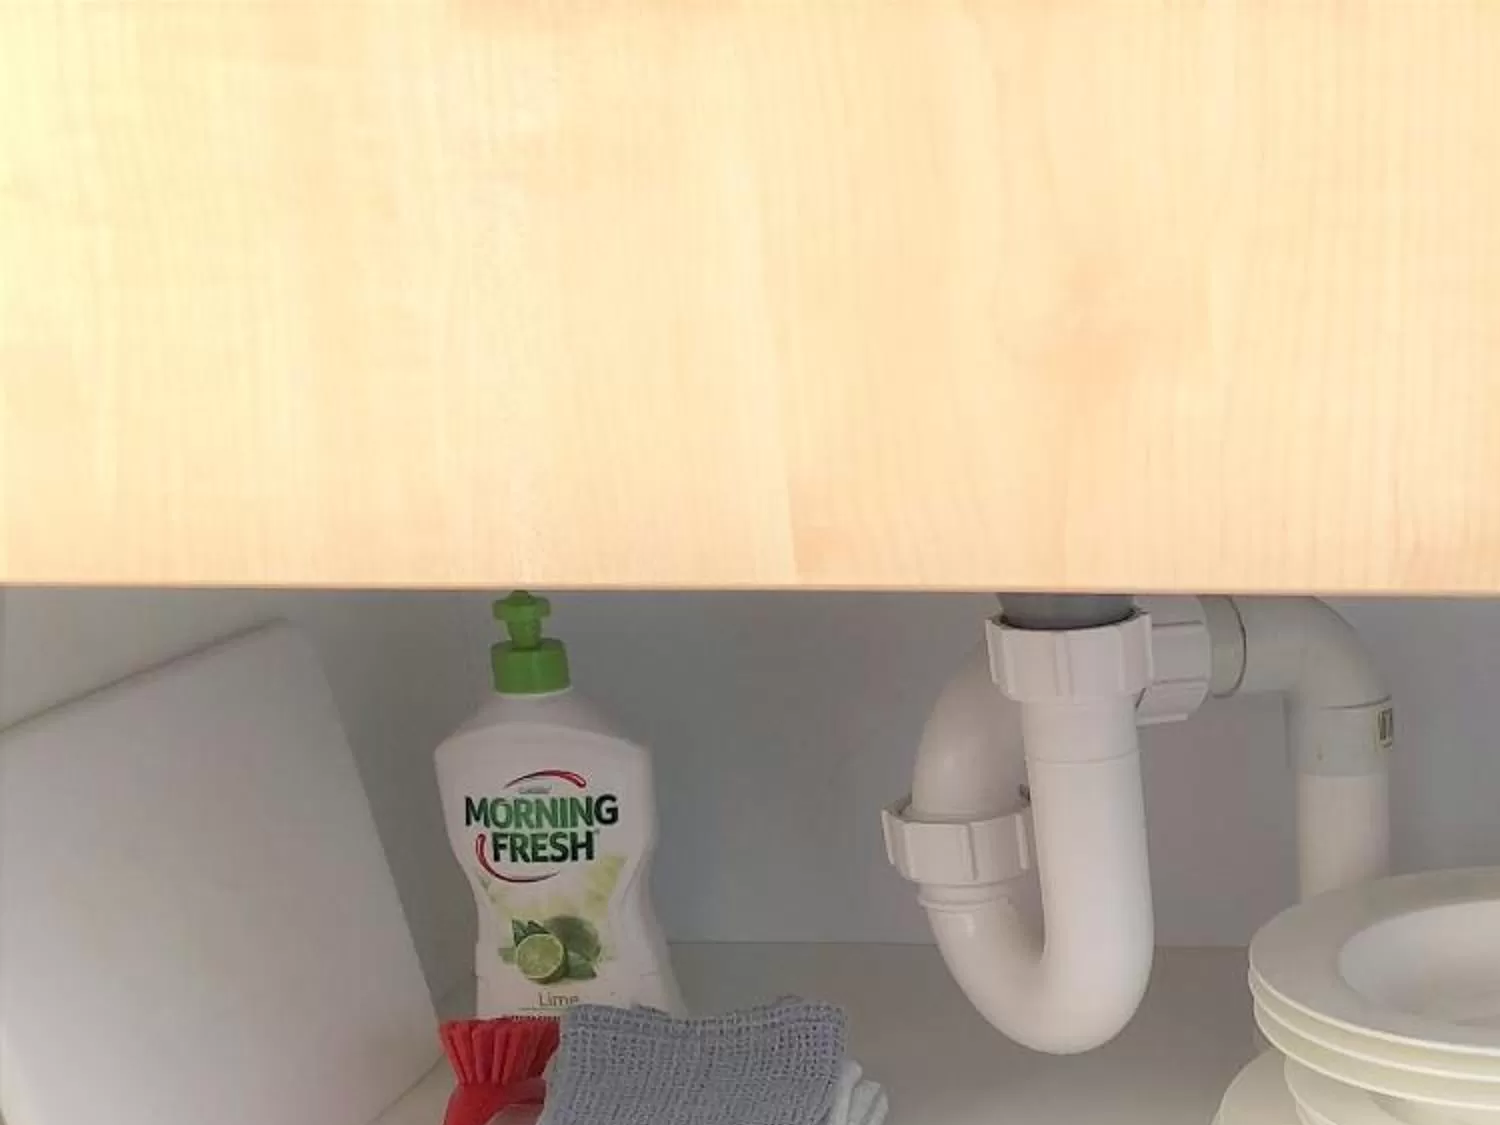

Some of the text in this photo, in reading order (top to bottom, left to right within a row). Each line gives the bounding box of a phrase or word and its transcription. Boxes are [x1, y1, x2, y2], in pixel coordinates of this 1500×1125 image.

[465, 794, 619, 829] MORNING
[492, 831, 595, 863] FRESH
[538, 992, 580, 1007] Lime
